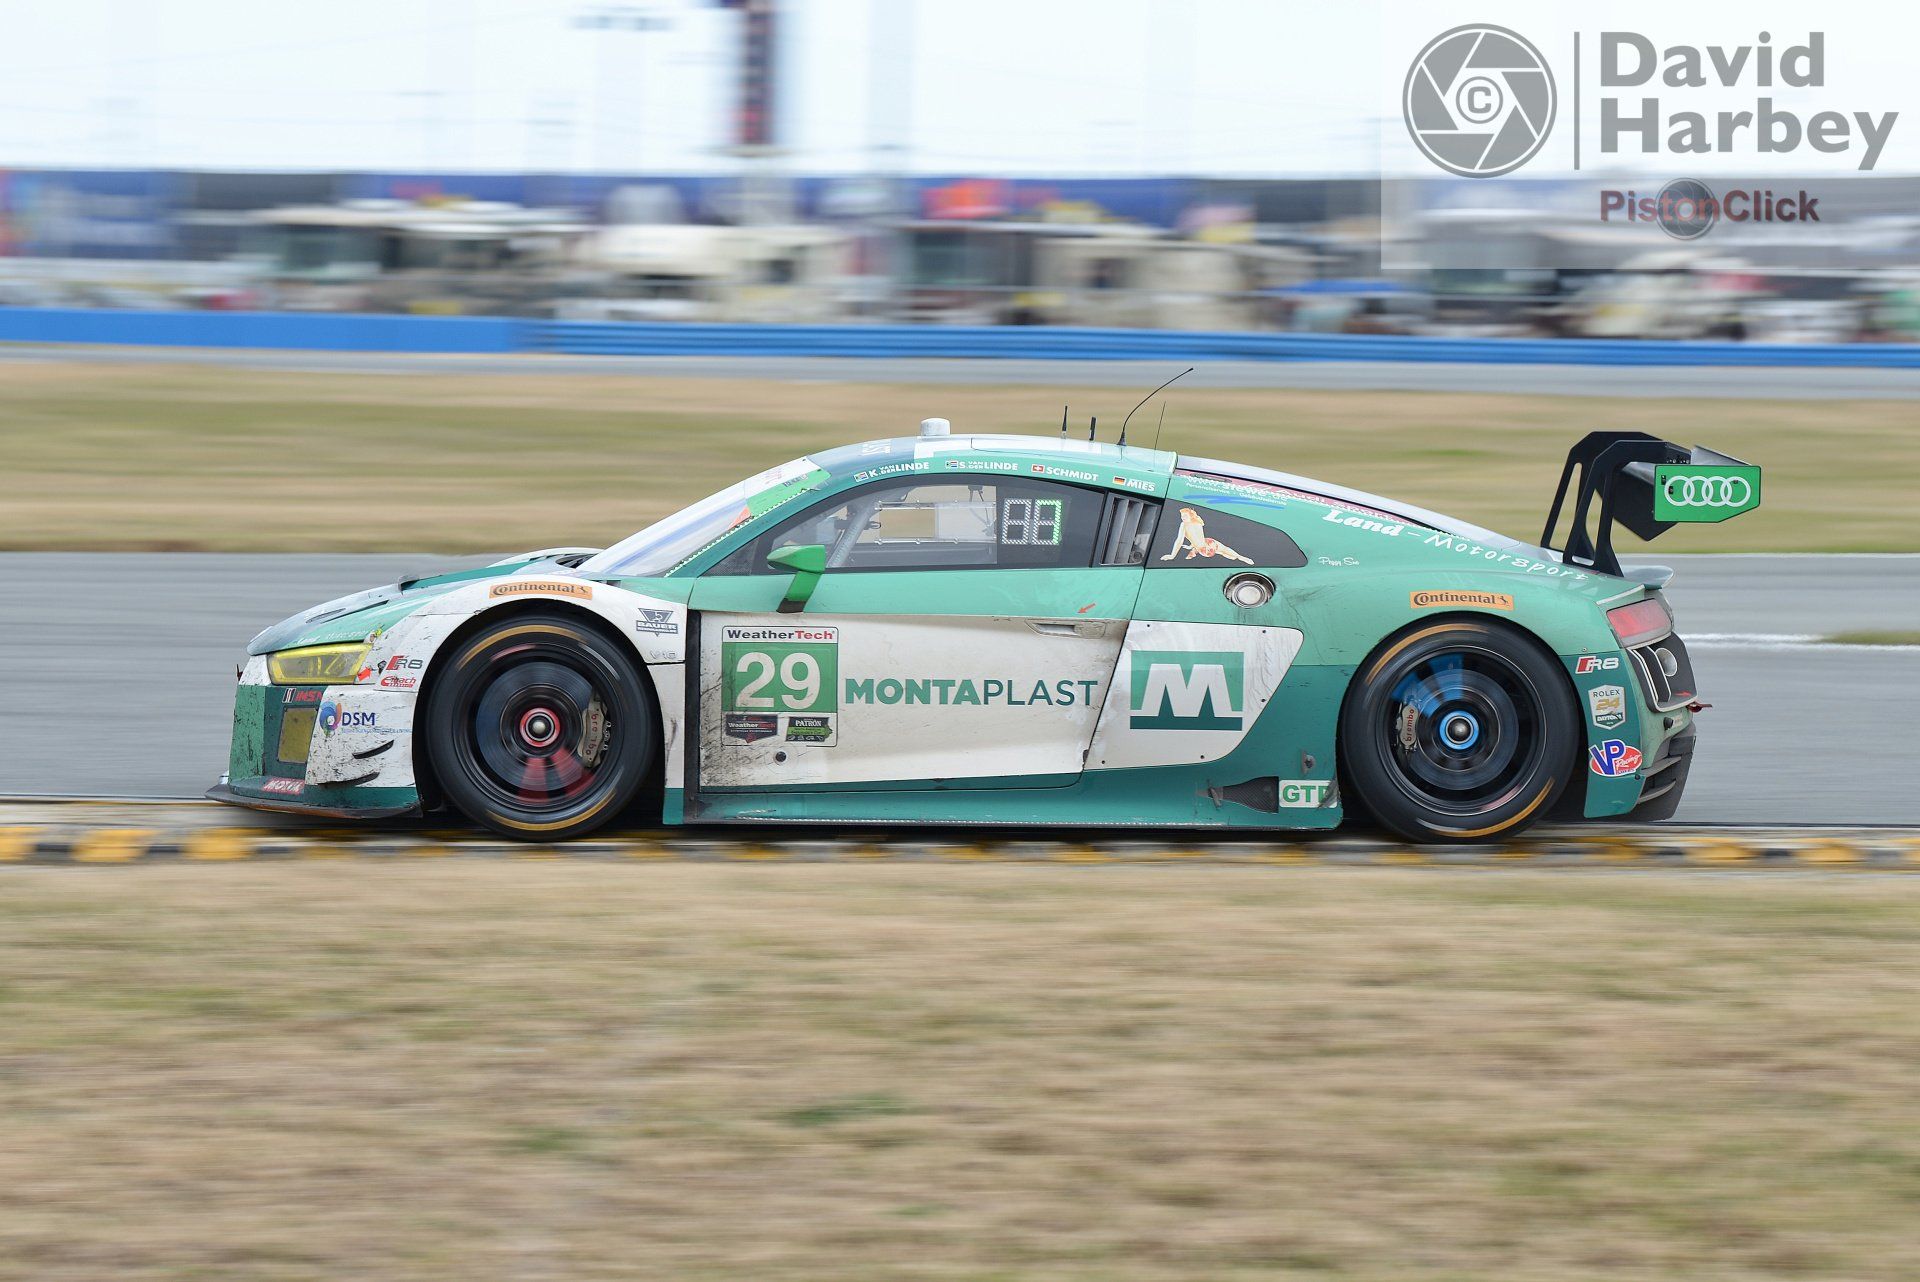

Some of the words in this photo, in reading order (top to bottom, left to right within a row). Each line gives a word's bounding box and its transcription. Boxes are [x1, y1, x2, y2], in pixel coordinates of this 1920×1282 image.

[895, 462, 930, 471] LINDE
[984, 462, 1019, 470] LINDE
[1046, 466, 1099, 481] SCHMIDT
[1126, 478, 1156, 491] MIES
[1322, 509, 1404, 537] Land
[1424, 535, 1590, 581] Motorsport
[493, 582, 575, 595] Continental
[1413, 592, 1496, 606] Continental
[636, 621, 677, 631] BAUER
[727, 630, 833, 640] WeatherTech
[736, 652, 821, 710] 29
[845, 678, 1098, 706] MONTAPLAST
[1593, 689, 1620, 698] ROLEX
[1596, 698, 1619, 710] 24
[341, 712, 375, 726] DSM
[1405, 708, 1415, 742] brembo
[1588, 739, 1626, 776] VP
